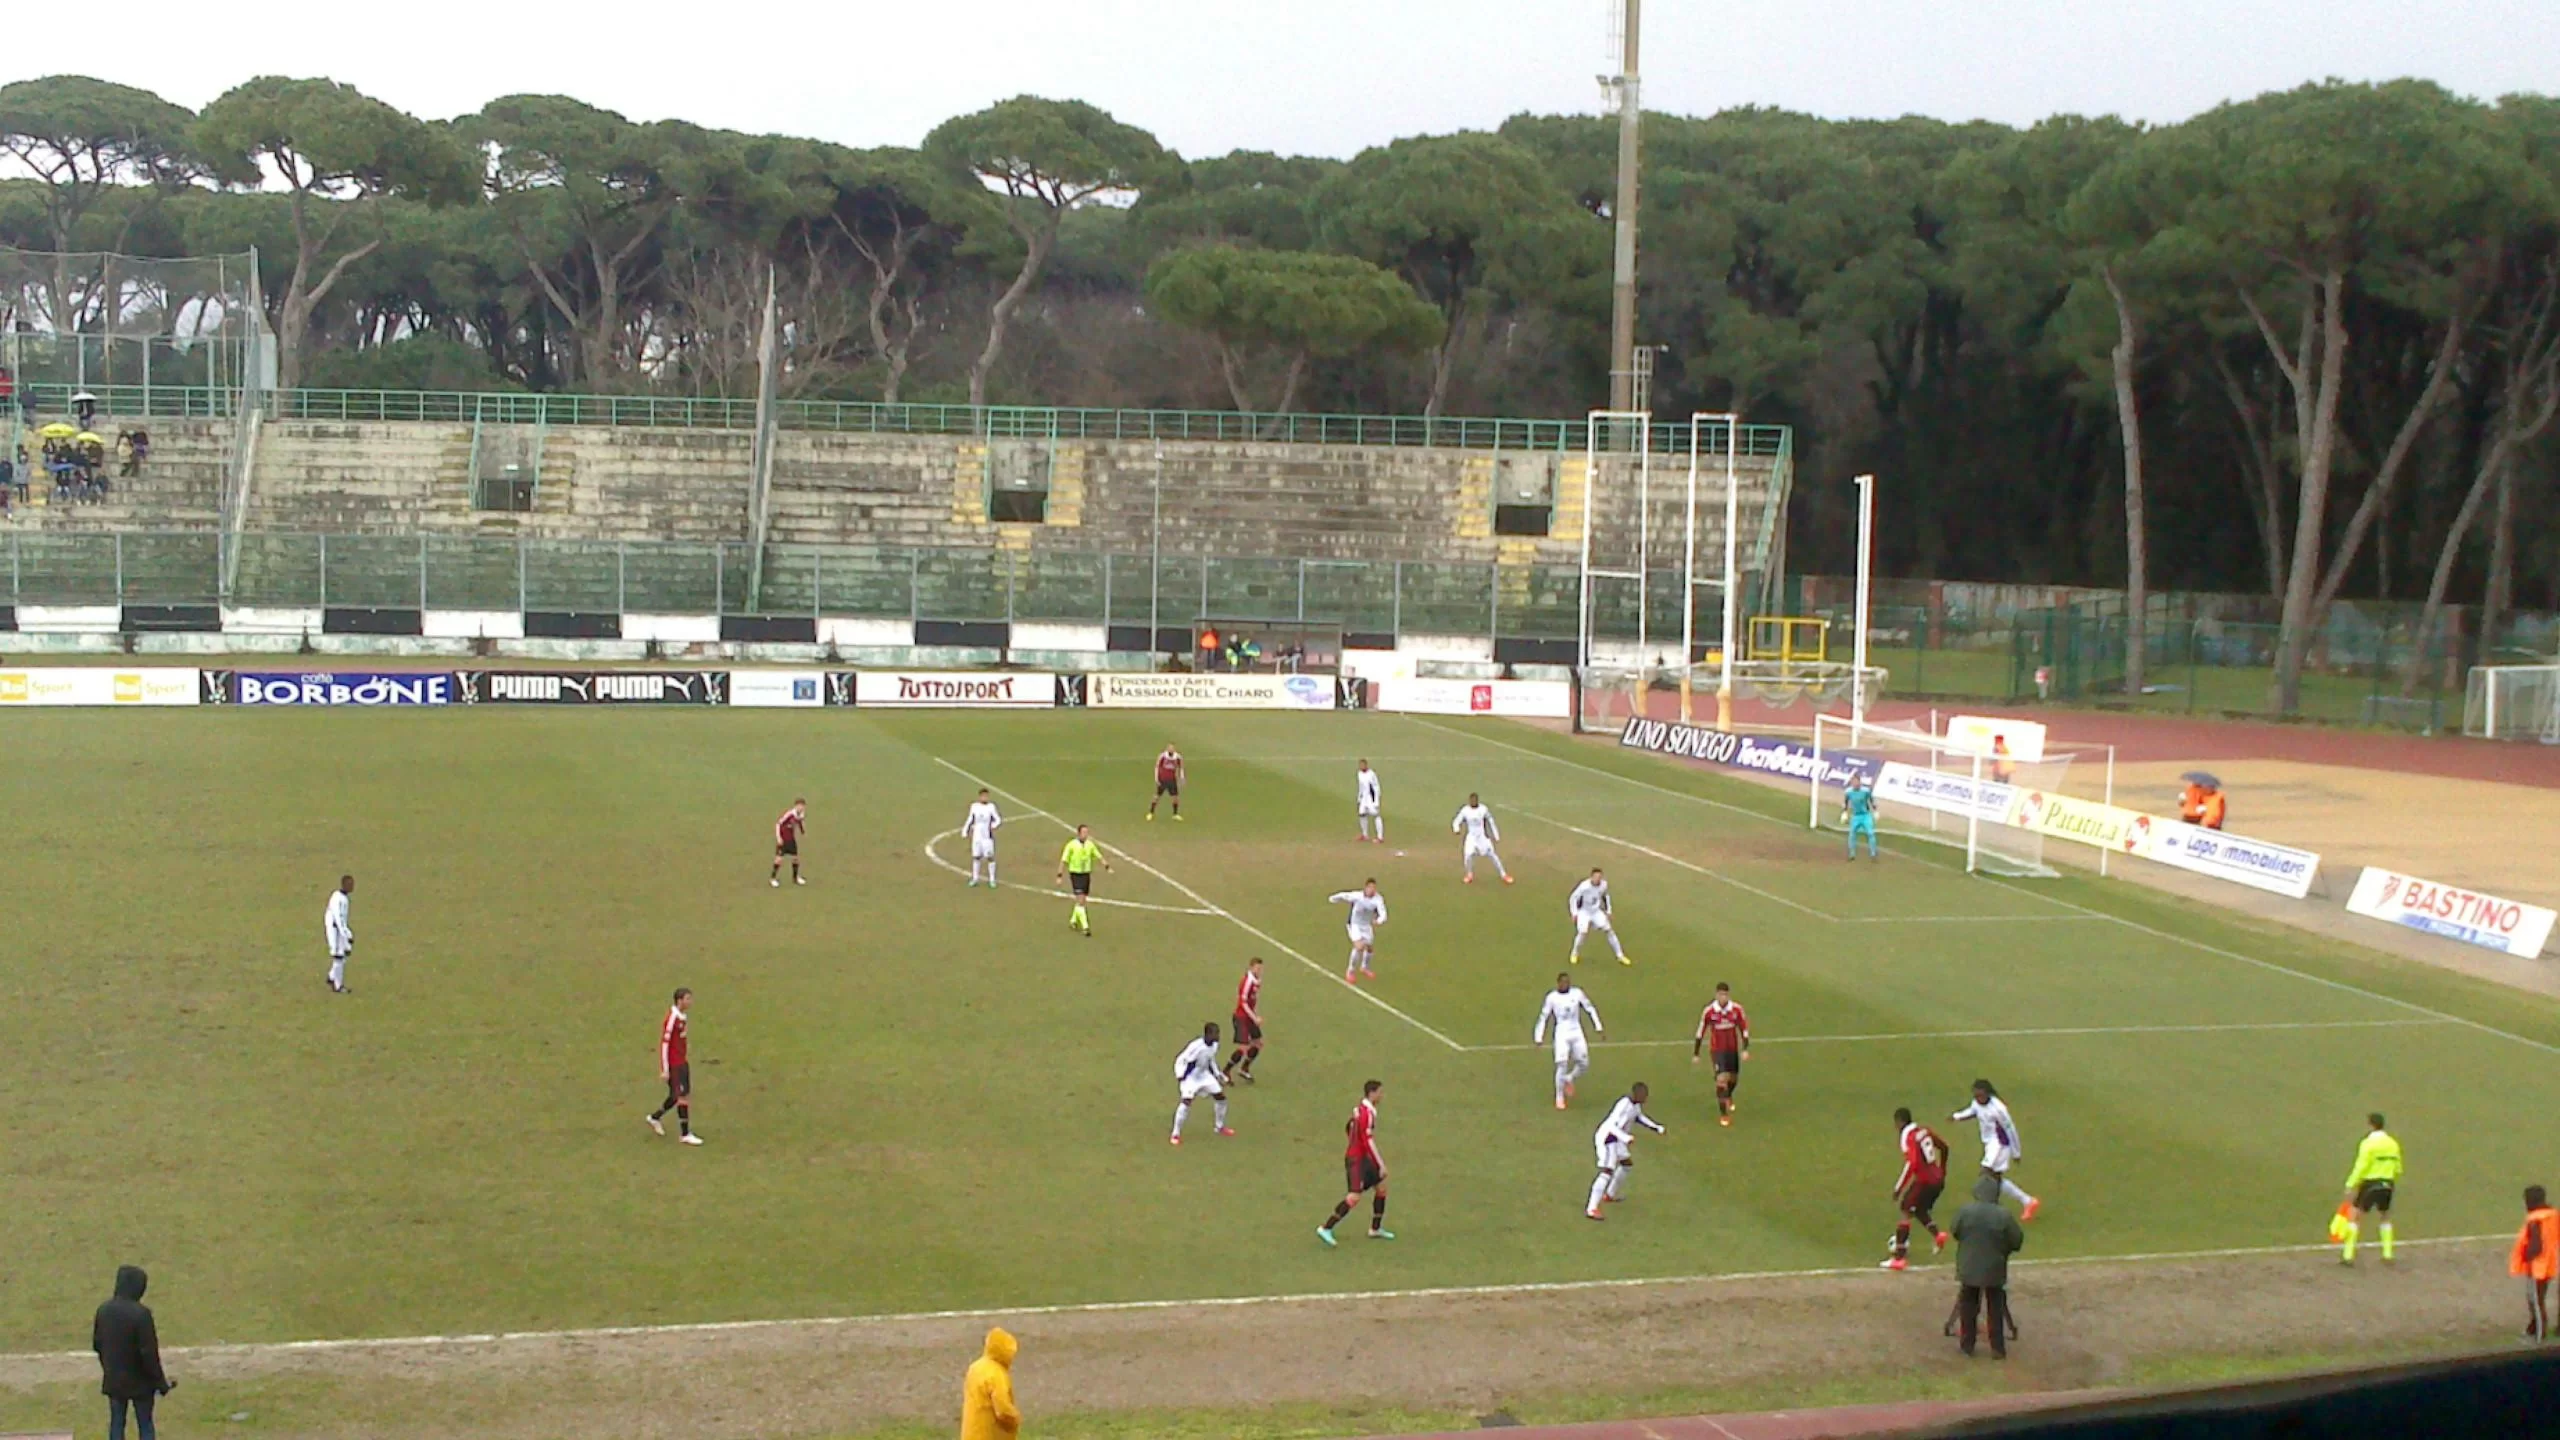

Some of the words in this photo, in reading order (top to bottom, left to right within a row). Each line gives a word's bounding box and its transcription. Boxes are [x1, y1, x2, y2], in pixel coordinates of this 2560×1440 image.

[491, 675, 561, 699] PUMA
[595, 675, 663, 700] PUMA
[898, 677, 1014, 699] TUTTOSPORT
[1110, 687, 1178, 698] MASSIMO
[1183, 687, 1212, 698] DEL
[1216, 687, 1273, 699] CHIARO
[1622, 718, 1667, 750] LINO
[1664, 725, 1736, 763] SONEGO
[2402, 881, 2522, 933] BASTINO
